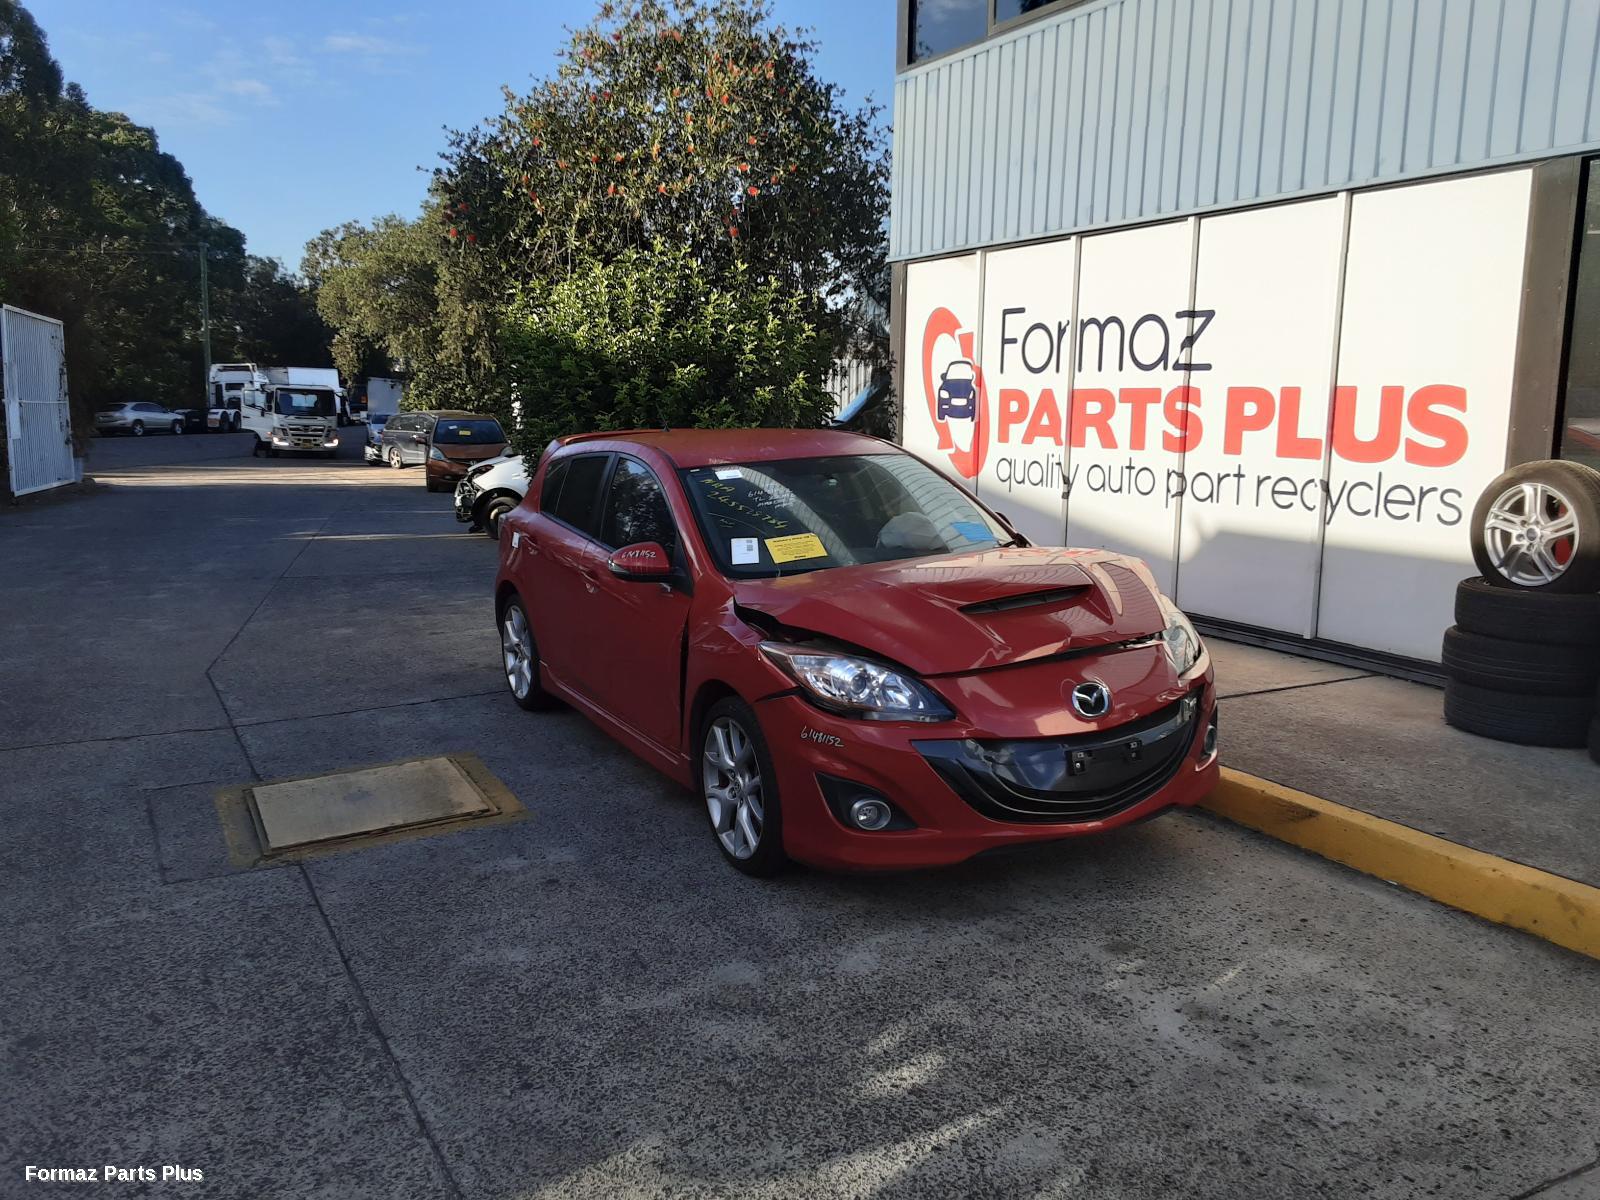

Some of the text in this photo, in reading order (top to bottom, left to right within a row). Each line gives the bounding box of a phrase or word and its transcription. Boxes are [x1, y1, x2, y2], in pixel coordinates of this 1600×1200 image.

[1000, 307, 1216, 374] Formaz
[997, 384, 1469, 468] PARTS PLUS
[996, 453, 1463, 526] quality auto part recyclers
[800, 725, 845, 747] 61481152
